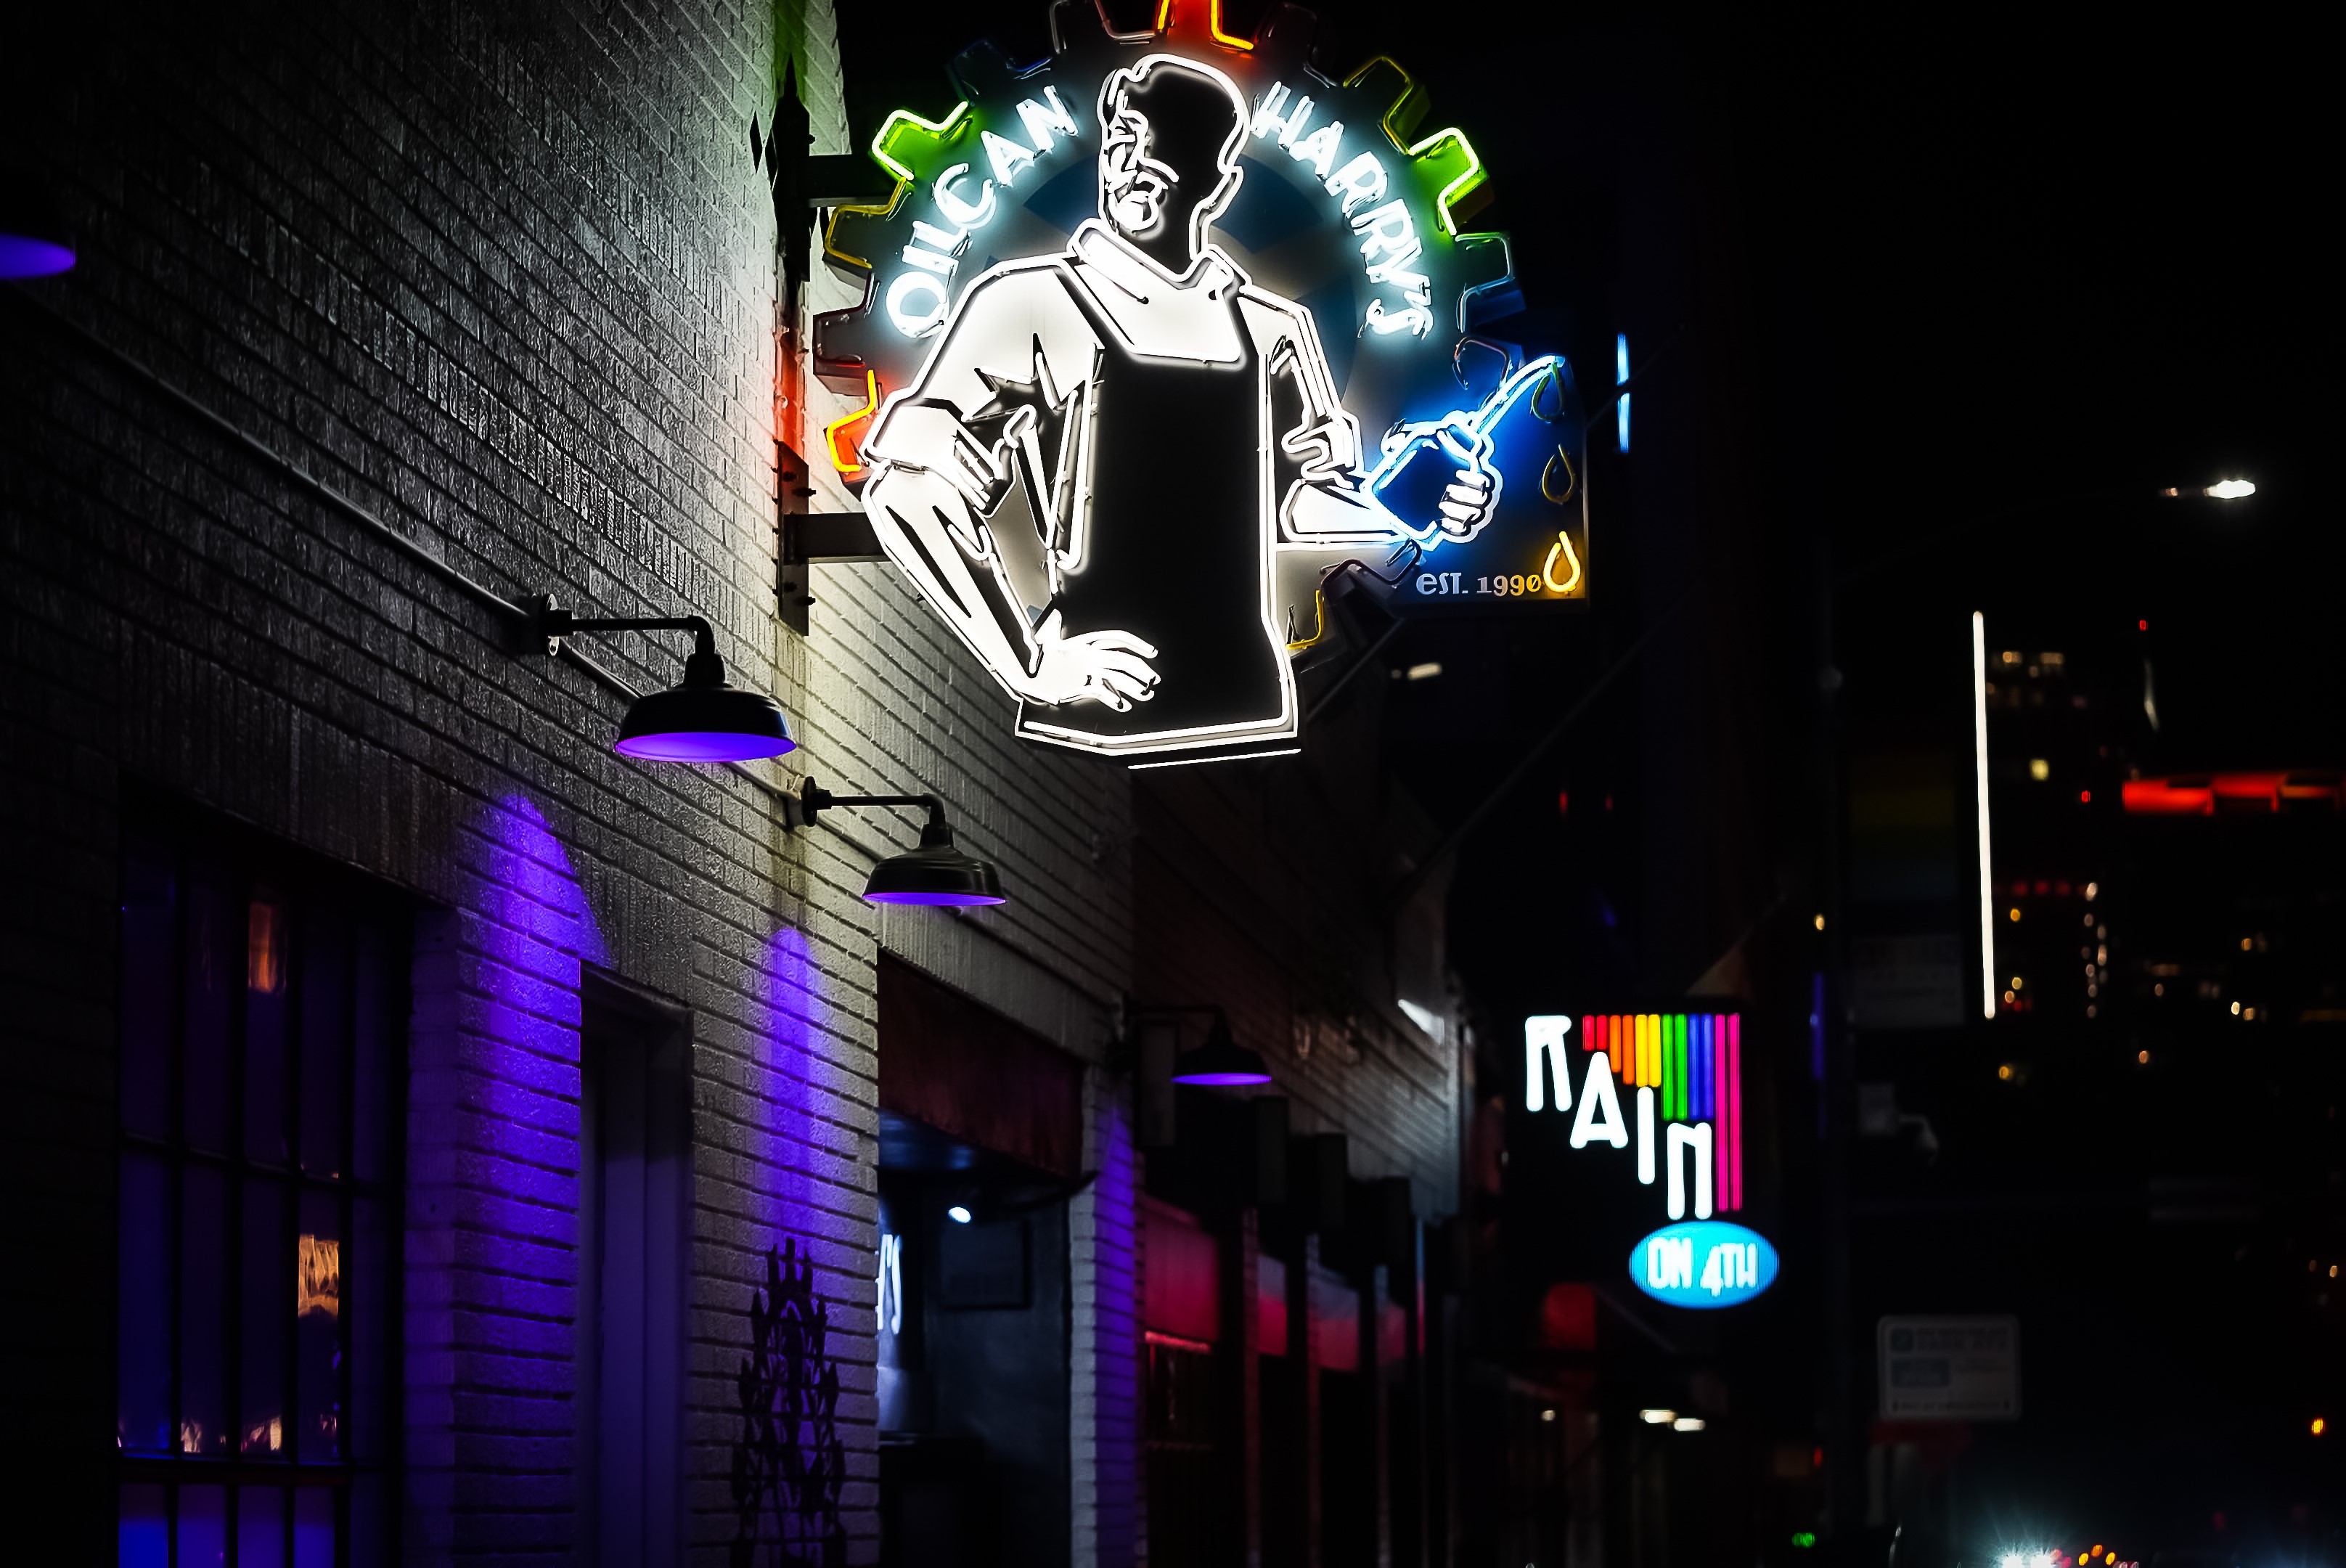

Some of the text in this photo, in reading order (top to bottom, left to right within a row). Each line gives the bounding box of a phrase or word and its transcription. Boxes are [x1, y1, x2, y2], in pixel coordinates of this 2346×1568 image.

[886, 81, 1434, 340] OILCAN HARRY'S
[1476, 574, 1542, 597] 1990
[1647, 1237, 1757, 1297] ON 4TH
